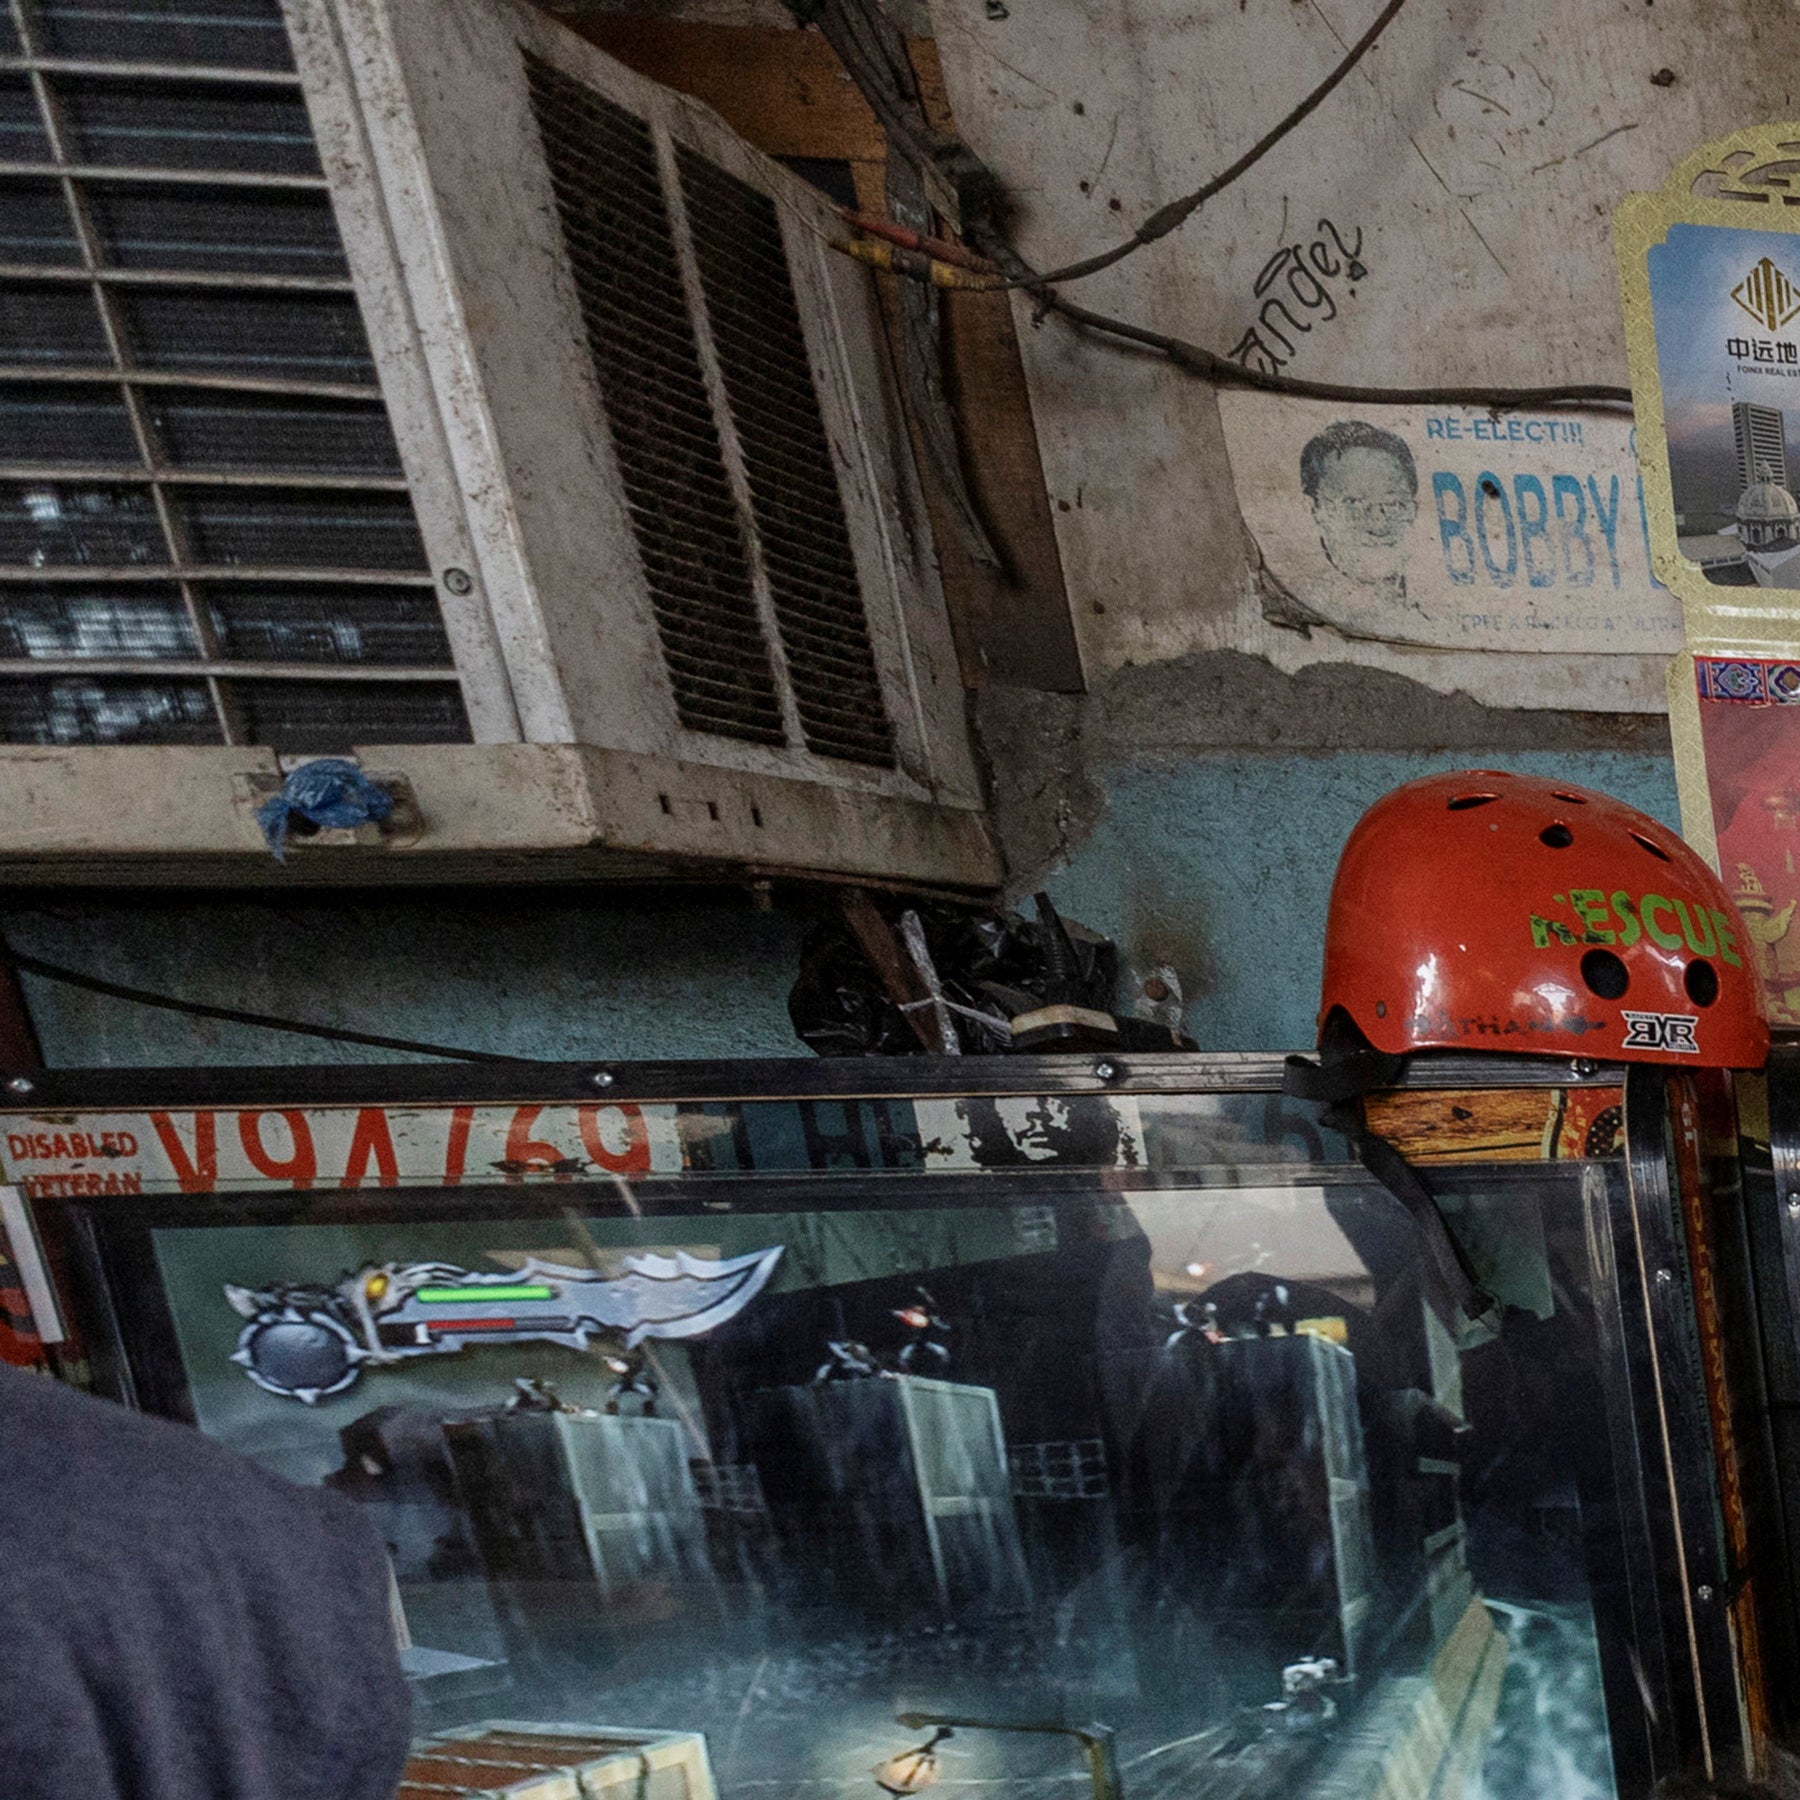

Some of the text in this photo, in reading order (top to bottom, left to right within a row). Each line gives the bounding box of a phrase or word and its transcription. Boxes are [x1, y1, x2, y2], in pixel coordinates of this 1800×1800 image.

[1426, 417, 1584, 444] RE-ELECT!!!
[1431, 470, 1621, 590] BOBBY
[8, 1131, 138, 1160] DISABLED
